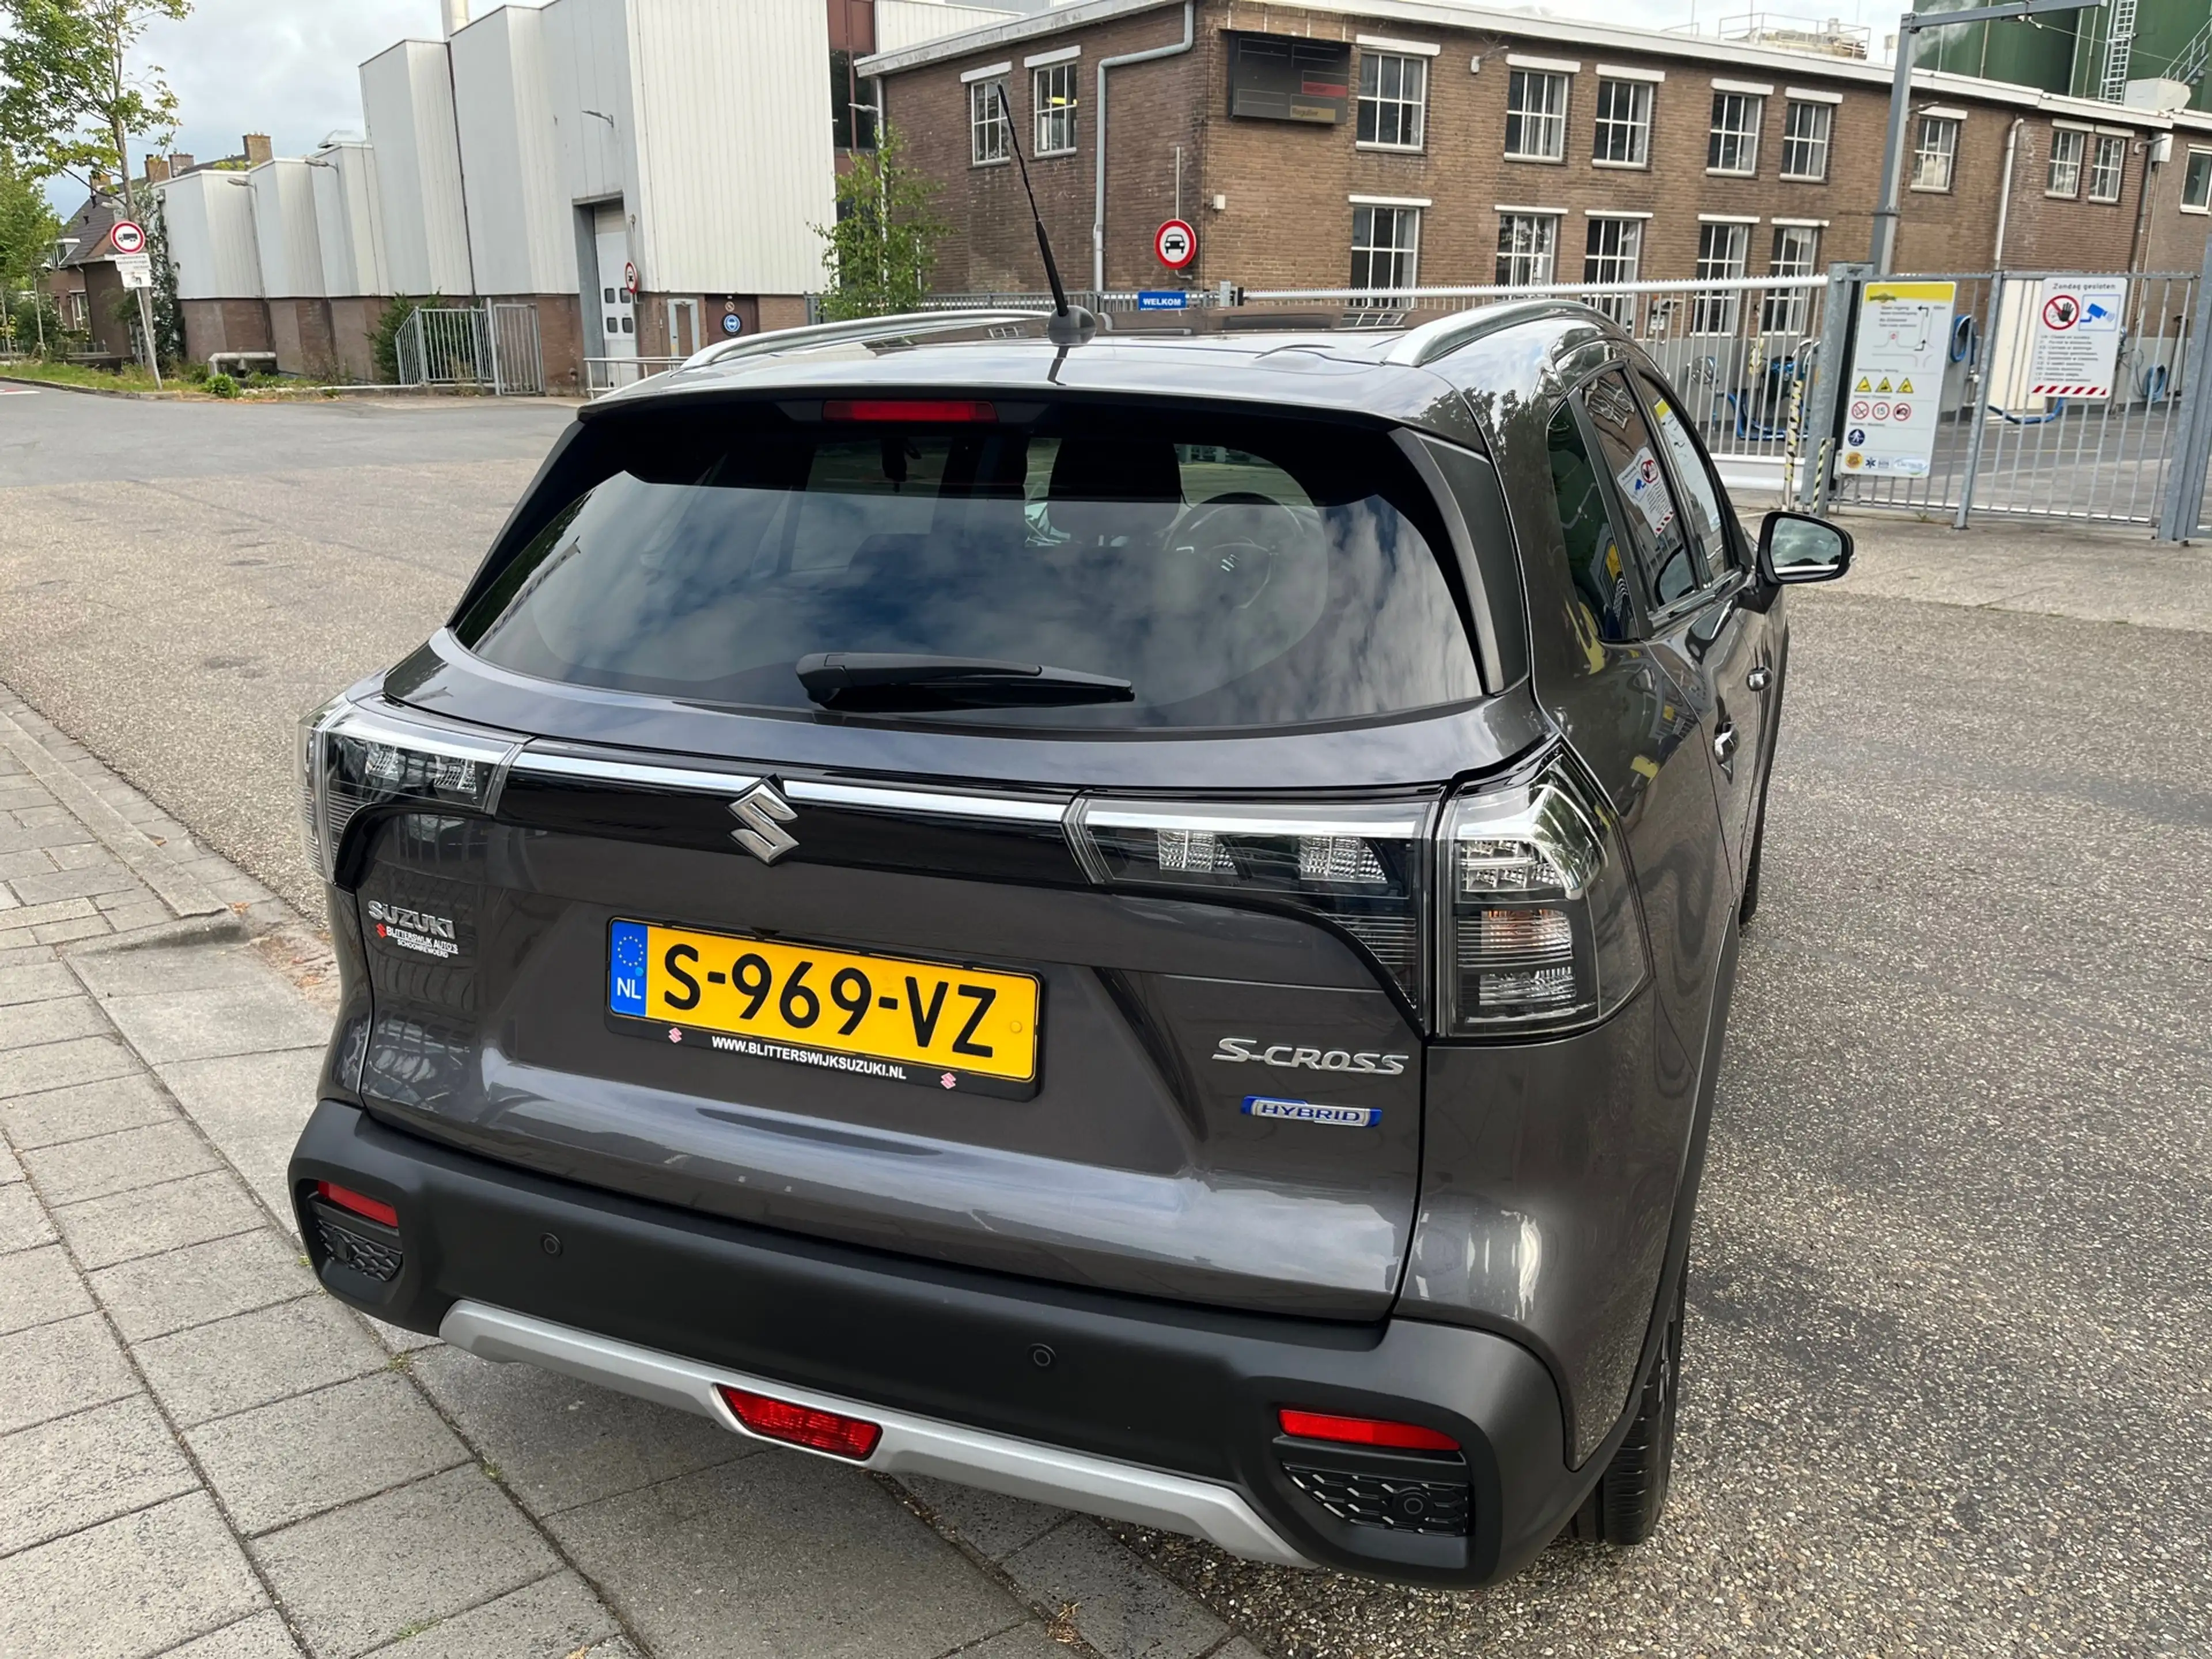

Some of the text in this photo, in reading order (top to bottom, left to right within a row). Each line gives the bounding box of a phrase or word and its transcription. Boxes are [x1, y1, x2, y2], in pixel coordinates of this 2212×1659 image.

[368, 900, 456, 940] SUZUKI
[433, 939, 459, 955] AUTO'S
[616, 977, 642, 1000] NL
[664, 943, 997, 1058] S-969-VZ
[712, 1036, 907, 1080] WWW.BLITTERSWIJKSUZUKI.NL
[1212, 1037, 1409, 1075] S-CROSS
[1262, 1104, 1360, 1122] HYBRID
